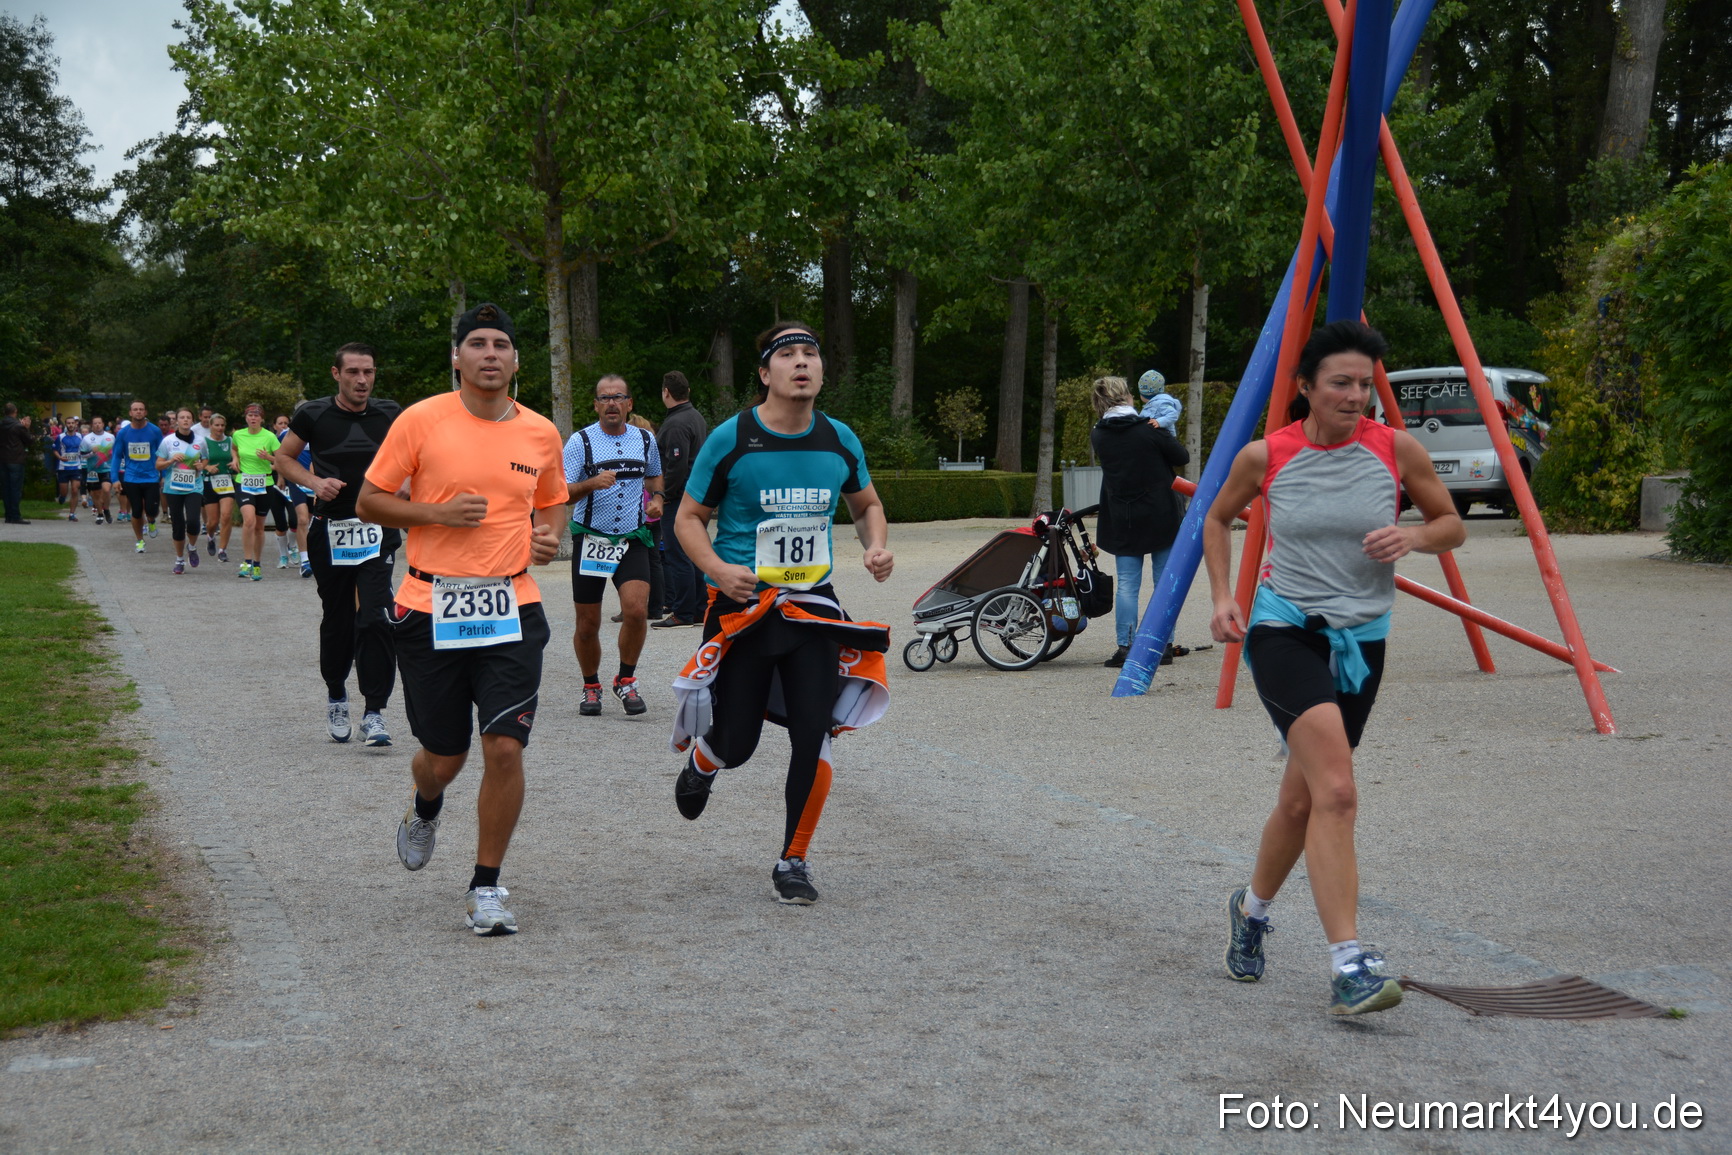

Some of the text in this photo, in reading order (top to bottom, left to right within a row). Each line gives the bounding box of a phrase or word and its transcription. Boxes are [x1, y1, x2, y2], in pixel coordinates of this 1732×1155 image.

[1440, 463, 1450, 471] 22
[173, 473, 194, 484] 2500
[215, 479, 229, 487] 233
[243, 477, 265, 487] 2309
[760, 487, 832, 505] HUBER
[759, 525, 819, 534] PARTL Neumarkt
[335, 527, 378, 546] 2116
[586, 542, 624, 562] 2823
[774, 535, 815, 563] 181
[596, 563, 613, 572] Peter
[783, 570, 806, 581] Sven
[434, 581, 462, 590] PARTL
[442, 588, 511, 619] 2330
[458, 623, 497, 637] Patrick
